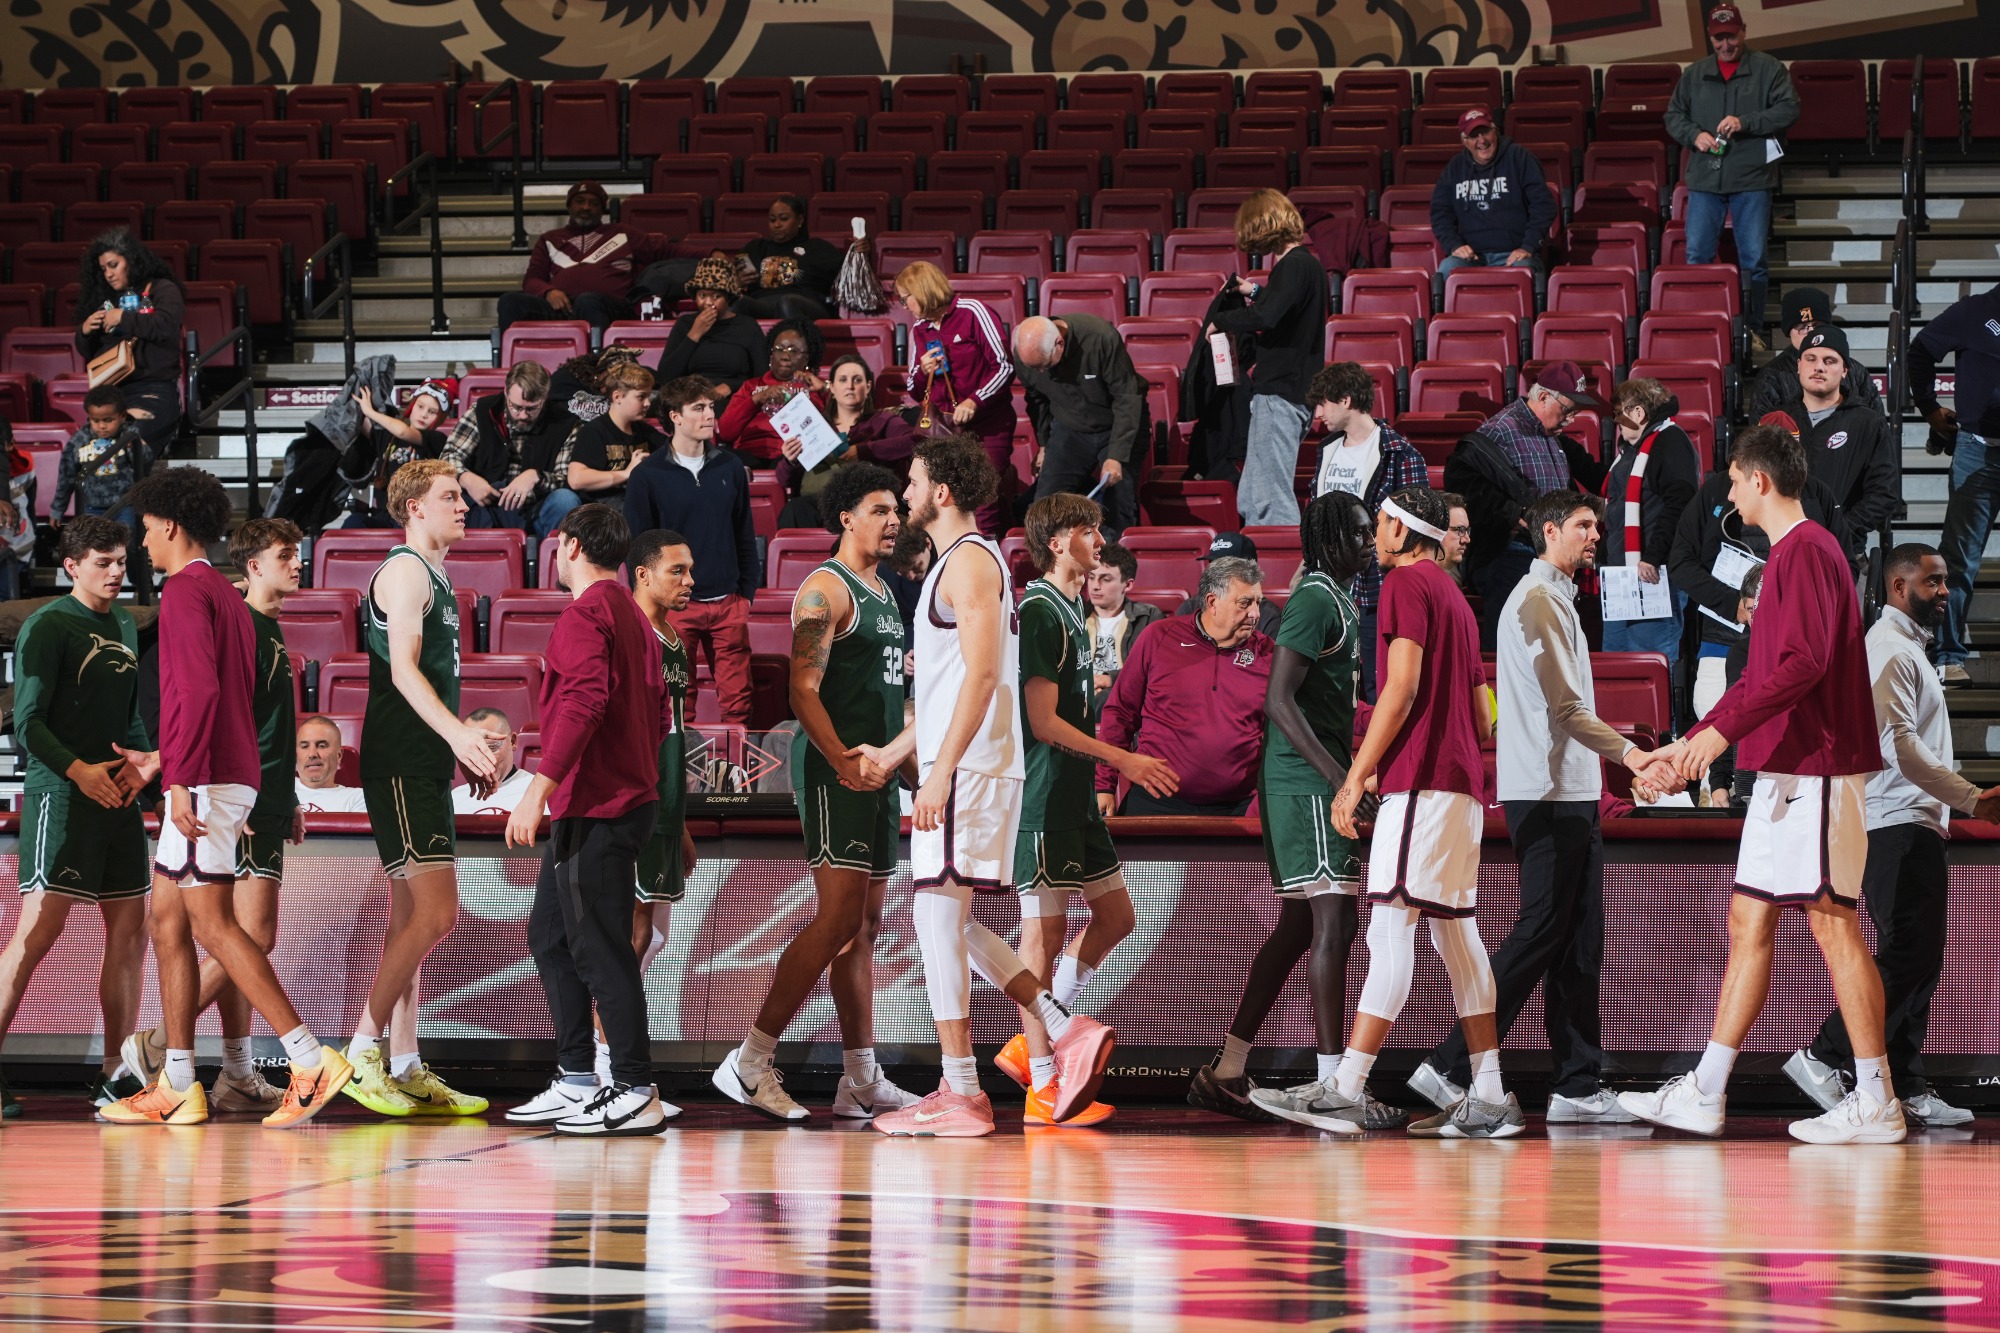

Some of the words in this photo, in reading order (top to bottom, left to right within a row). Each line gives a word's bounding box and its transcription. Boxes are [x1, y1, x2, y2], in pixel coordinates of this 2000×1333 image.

[1479, 176, 1509, 195] SATE
[1801, 309, 1813, 322] 21
[291, 391, 338, 403] Sectio
[1328, 464, 1357, 478] Treat
[1324, 479, 1362, 493] ourself
[453, 638, 460, 677] 5
[883, 646, 904, 685] 32
[1103, 1066, 1190, 1077] KTRONICS
